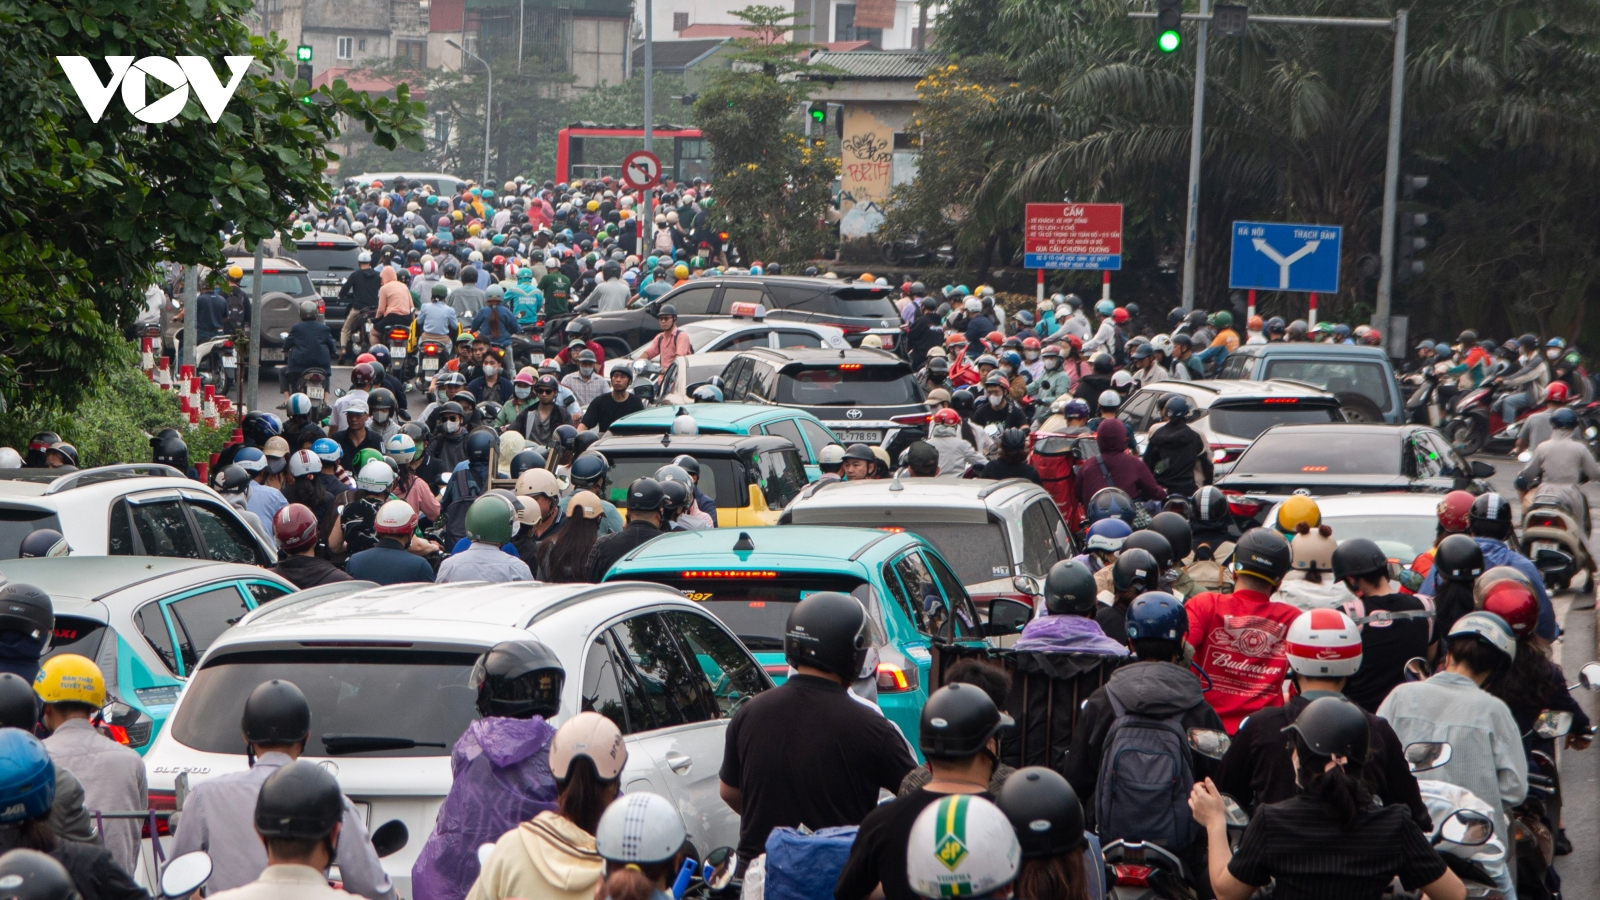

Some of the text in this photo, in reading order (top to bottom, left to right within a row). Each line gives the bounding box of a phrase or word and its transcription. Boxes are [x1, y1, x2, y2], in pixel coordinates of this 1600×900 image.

[1063, 204, 1084, 217] CẤM
[1238, 226, 1265, 239] HÀ NỘI
[1293, 230, 1336, 240] THẠCH BÀN
[1049, 245, 1060, 253] CẦU
[1211, 652, 1282, 675] Budweiser
